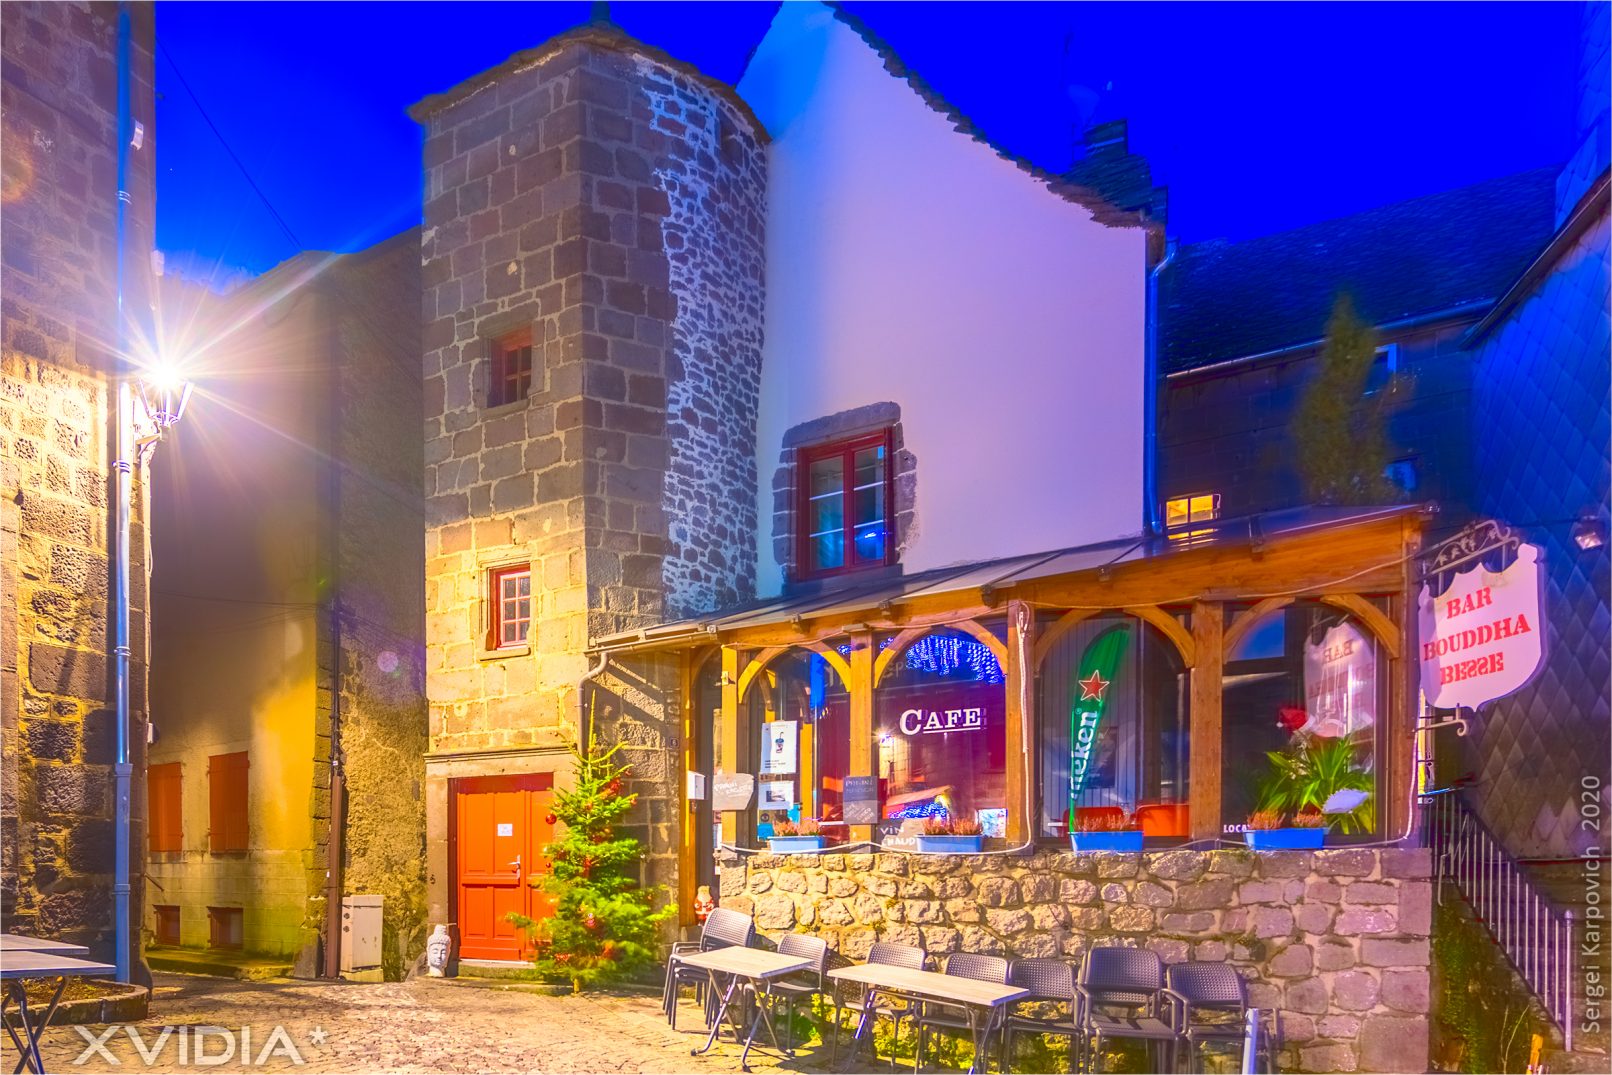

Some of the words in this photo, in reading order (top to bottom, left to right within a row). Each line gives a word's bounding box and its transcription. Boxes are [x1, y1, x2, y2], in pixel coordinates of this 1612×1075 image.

[1446, 586, 1493, 619] BAR
[1423, 613, 1532, 662] BOUDDHA
[1440, 652, 1505, 686] BESSE
[899, 707, 981, 736] CAFE
